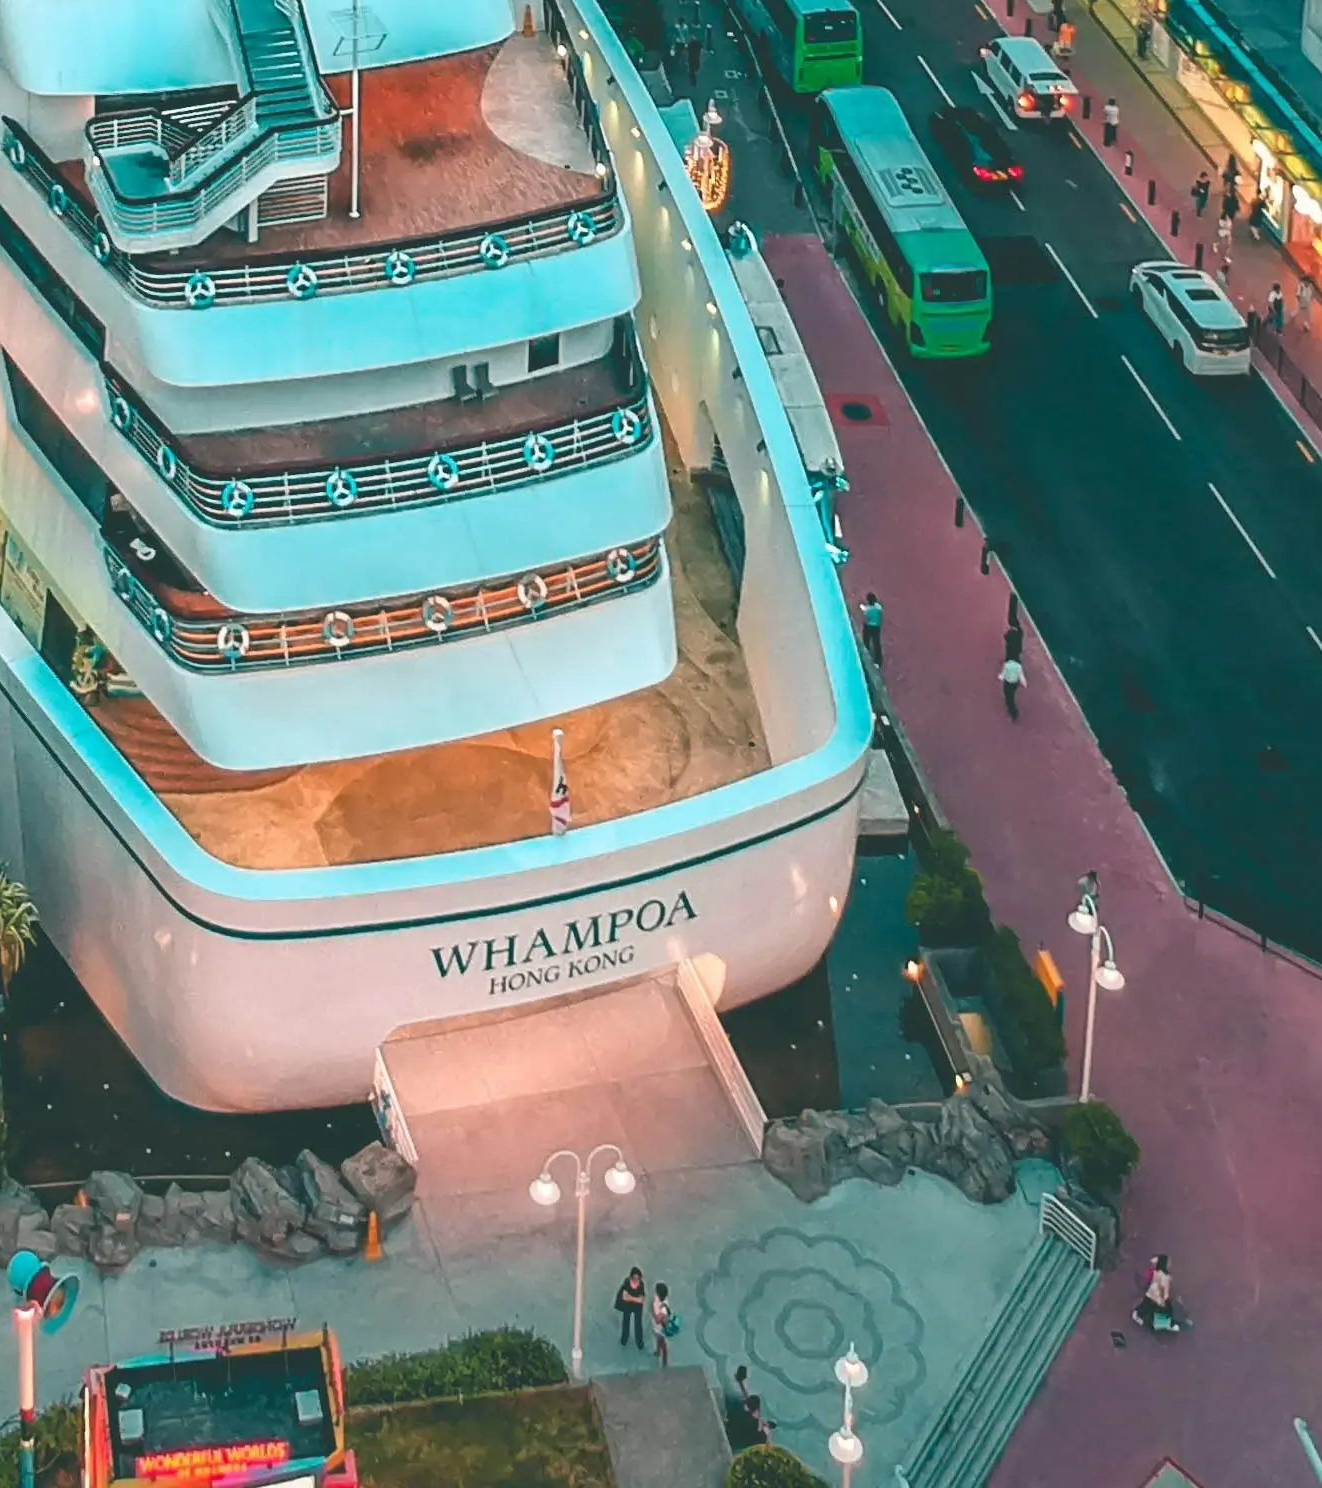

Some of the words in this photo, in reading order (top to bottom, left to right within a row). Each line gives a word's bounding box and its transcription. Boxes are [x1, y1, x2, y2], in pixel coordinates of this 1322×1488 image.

[429, 889, 698, 978] WHAMPOA
[488, 965, 561, 996] HONG
[567, 944, 636, 979] KONG
[226, 1442, 286, 1464] WORLDS
